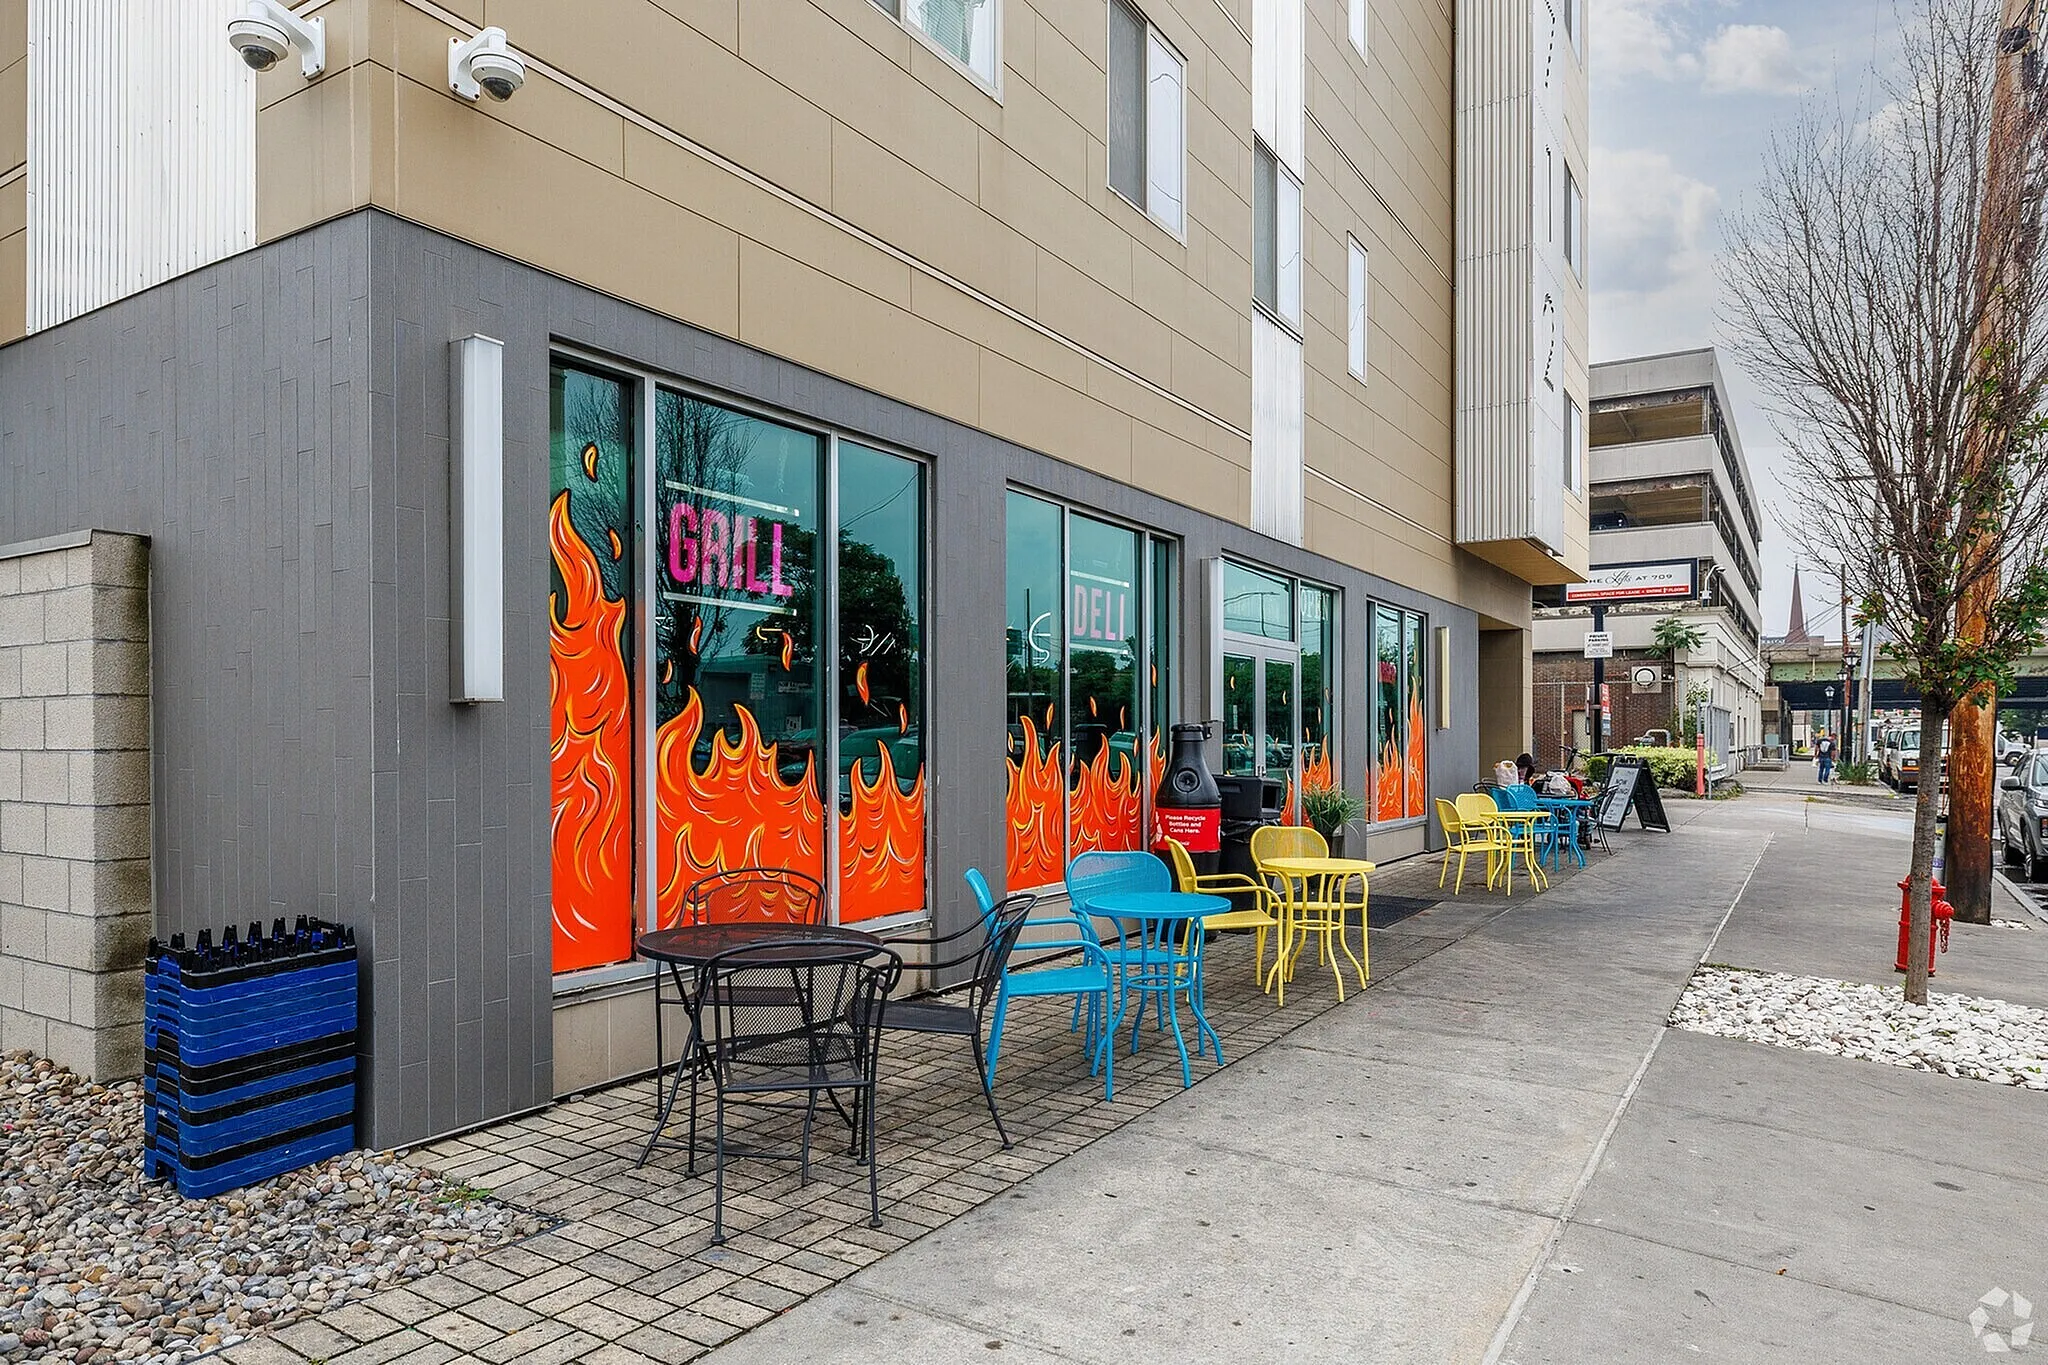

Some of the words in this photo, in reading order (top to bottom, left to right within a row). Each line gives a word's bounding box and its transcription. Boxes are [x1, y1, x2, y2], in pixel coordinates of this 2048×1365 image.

[669, 503, 793, 597] GRILL
[1605, 570, 1632, 588] Lofts
[1073, 584, 1125, 641] DELI
